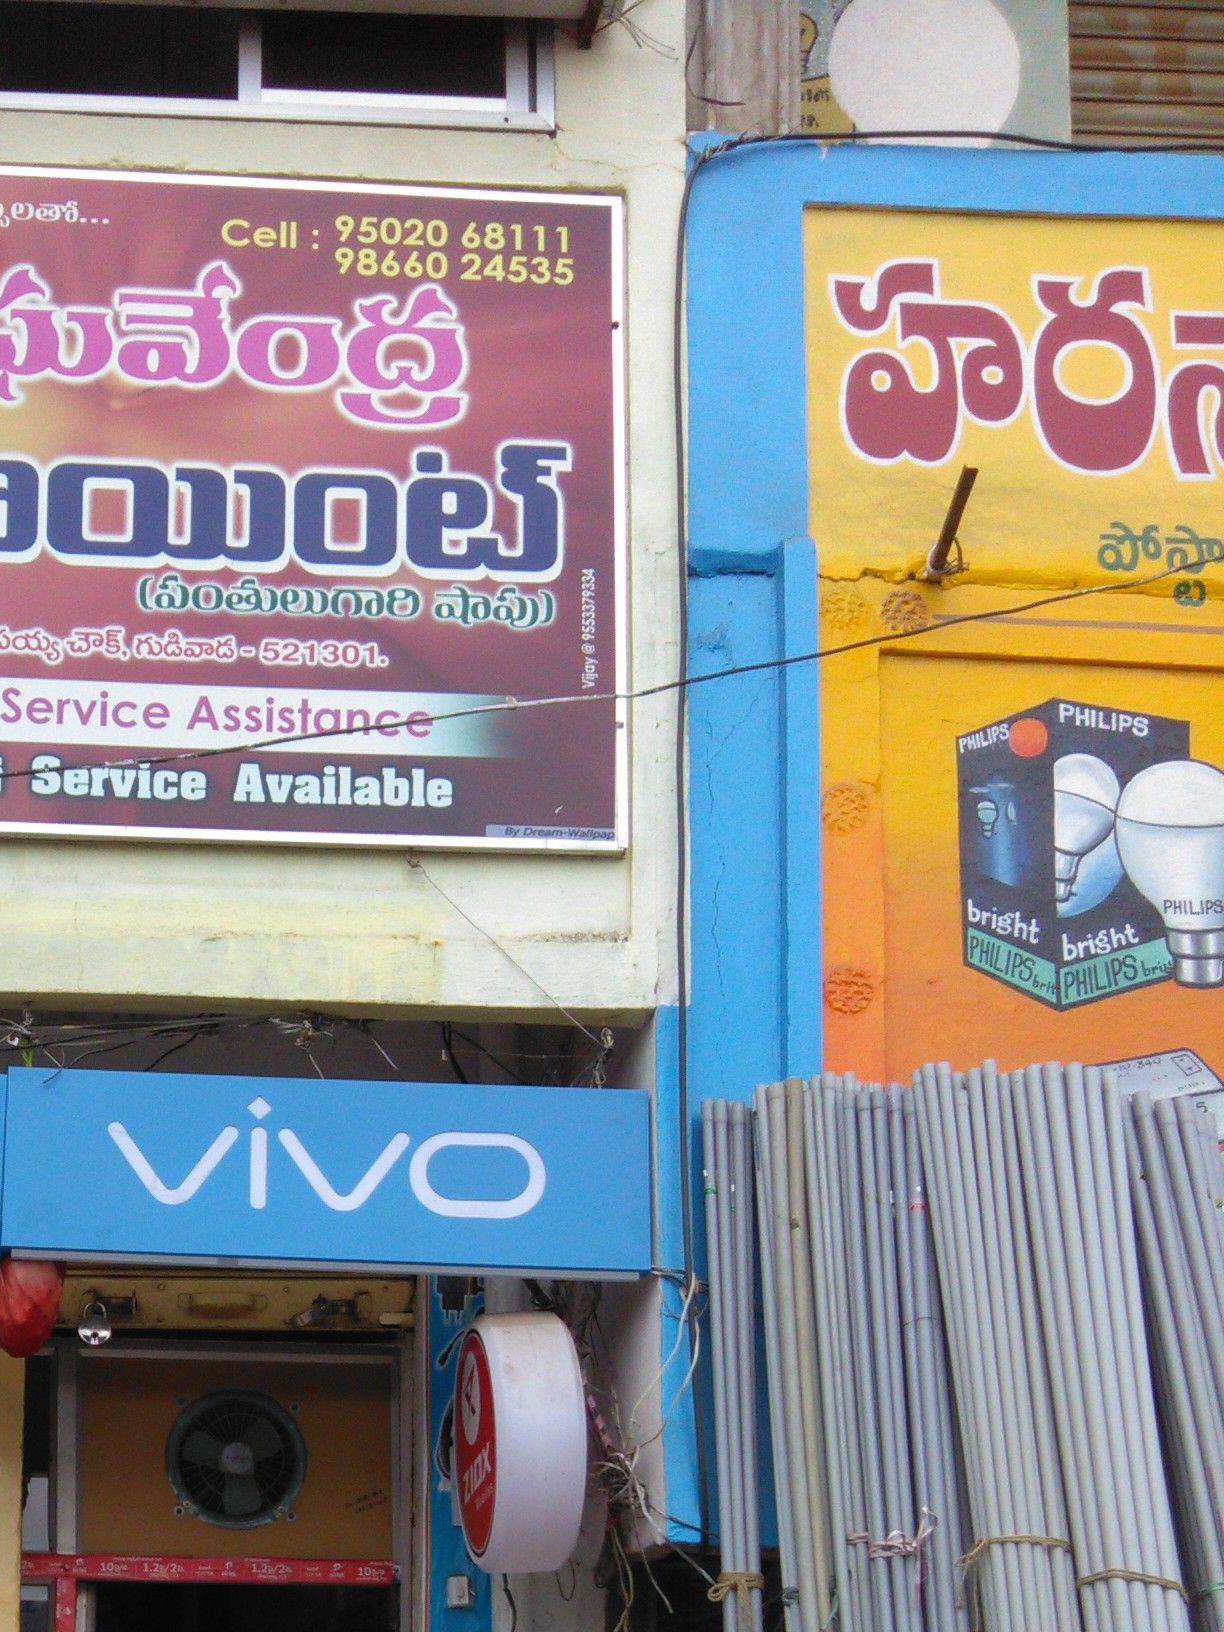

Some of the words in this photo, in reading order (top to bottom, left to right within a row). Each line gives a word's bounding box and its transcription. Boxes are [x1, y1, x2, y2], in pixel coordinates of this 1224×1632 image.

[221, 219, 296, 249] Cell
[335, 215, 448, 247] 95020
[461, 220, 571, 254] 68111
[335, 248, 448, 279] 98660
[461, 253, 574, 286] 24535
[581, 657, 599, 689] Vijay
[0, 686, 171, 731] Service
[186, 694, 435, 739] Assistance
[1058, 703, 1149, 737] PHILIPS
[958, 723, 1010, 754] PHILIPS
[31, 761, 208, 803] Service
[233, 763, 455, 810] Available
[967, 898, 1041, 944] bright
[1163, 899, 1223, 915] PHILIPS
[969, 932, 1033, 983] PHILIPS
[1062, 923, 1140, 962] bright
[1063, 955, 1138, 1000] PHILIPS
[107, 1096, 546, 1219] vivo
